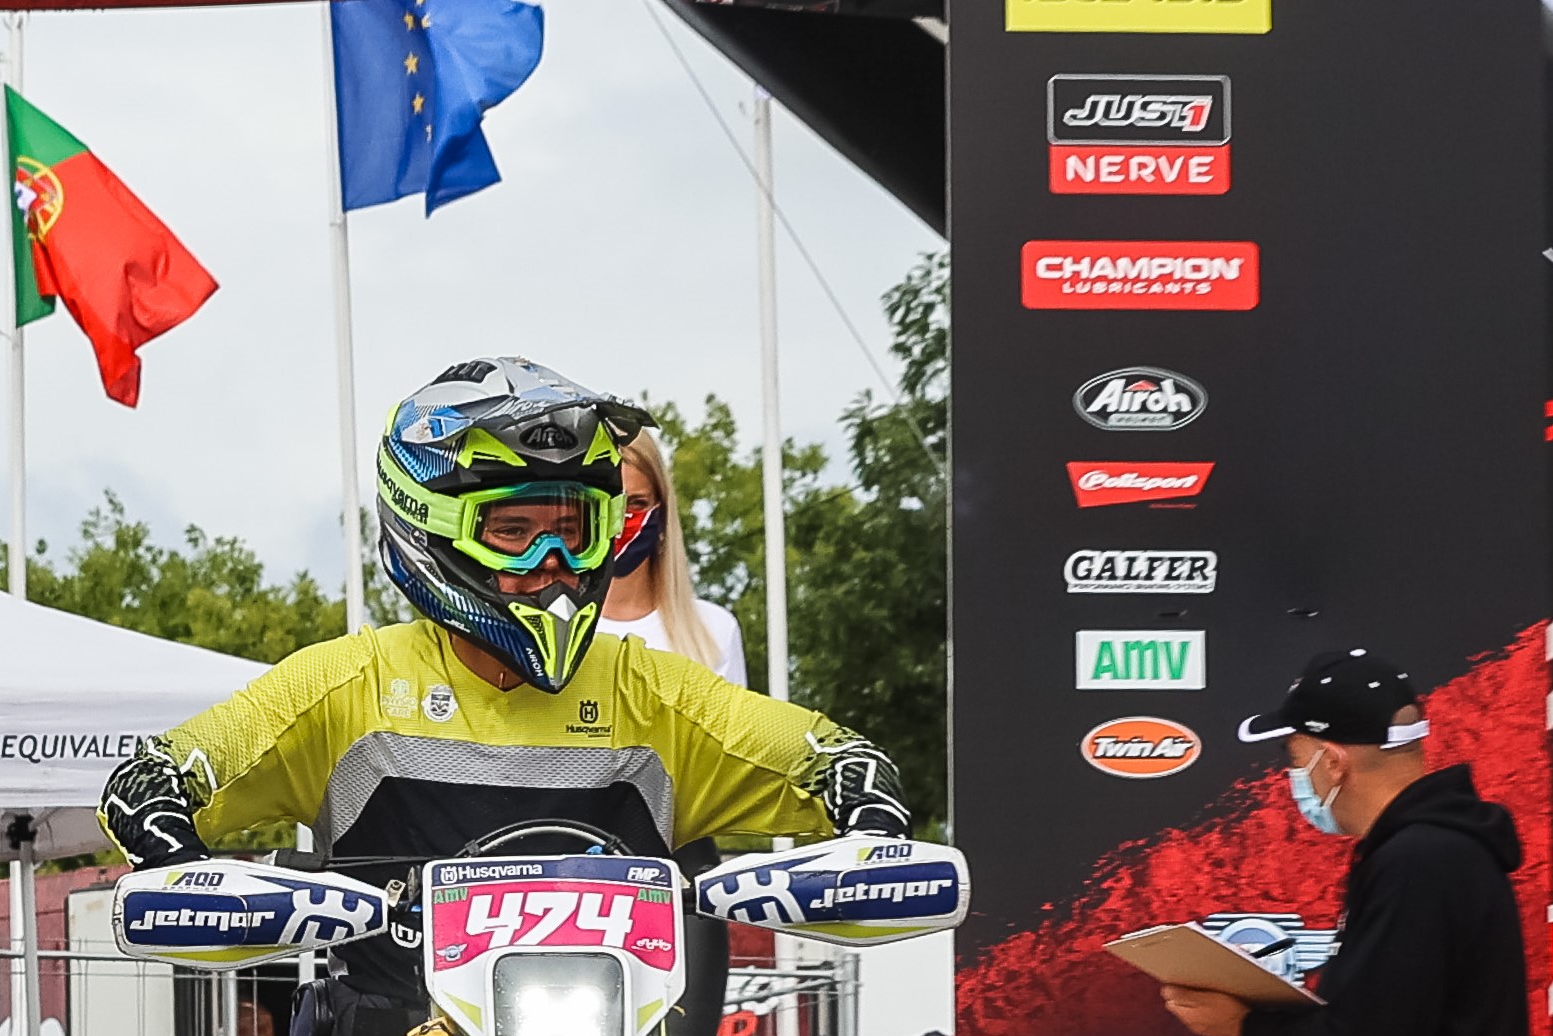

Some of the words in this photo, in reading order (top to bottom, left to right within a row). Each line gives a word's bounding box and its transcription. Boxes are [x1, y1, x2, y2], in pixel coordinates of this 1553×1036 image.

[1065, 154, 1215, 184] NERVE
[1035, 256, 1245, 280] CHAMPION
[1061, 281, 1213, 295] LUBRICANTS
[1085, 378, 1193, 413] Airoh
[1077, 470, 1199, 491] Polisport
[1071, 555, 1210, 581] GALFER
[526, 647, 544, 678] AIROH
[457, 863, 543, 880] Husqvarna
[465, 891, 635, 948] 474
